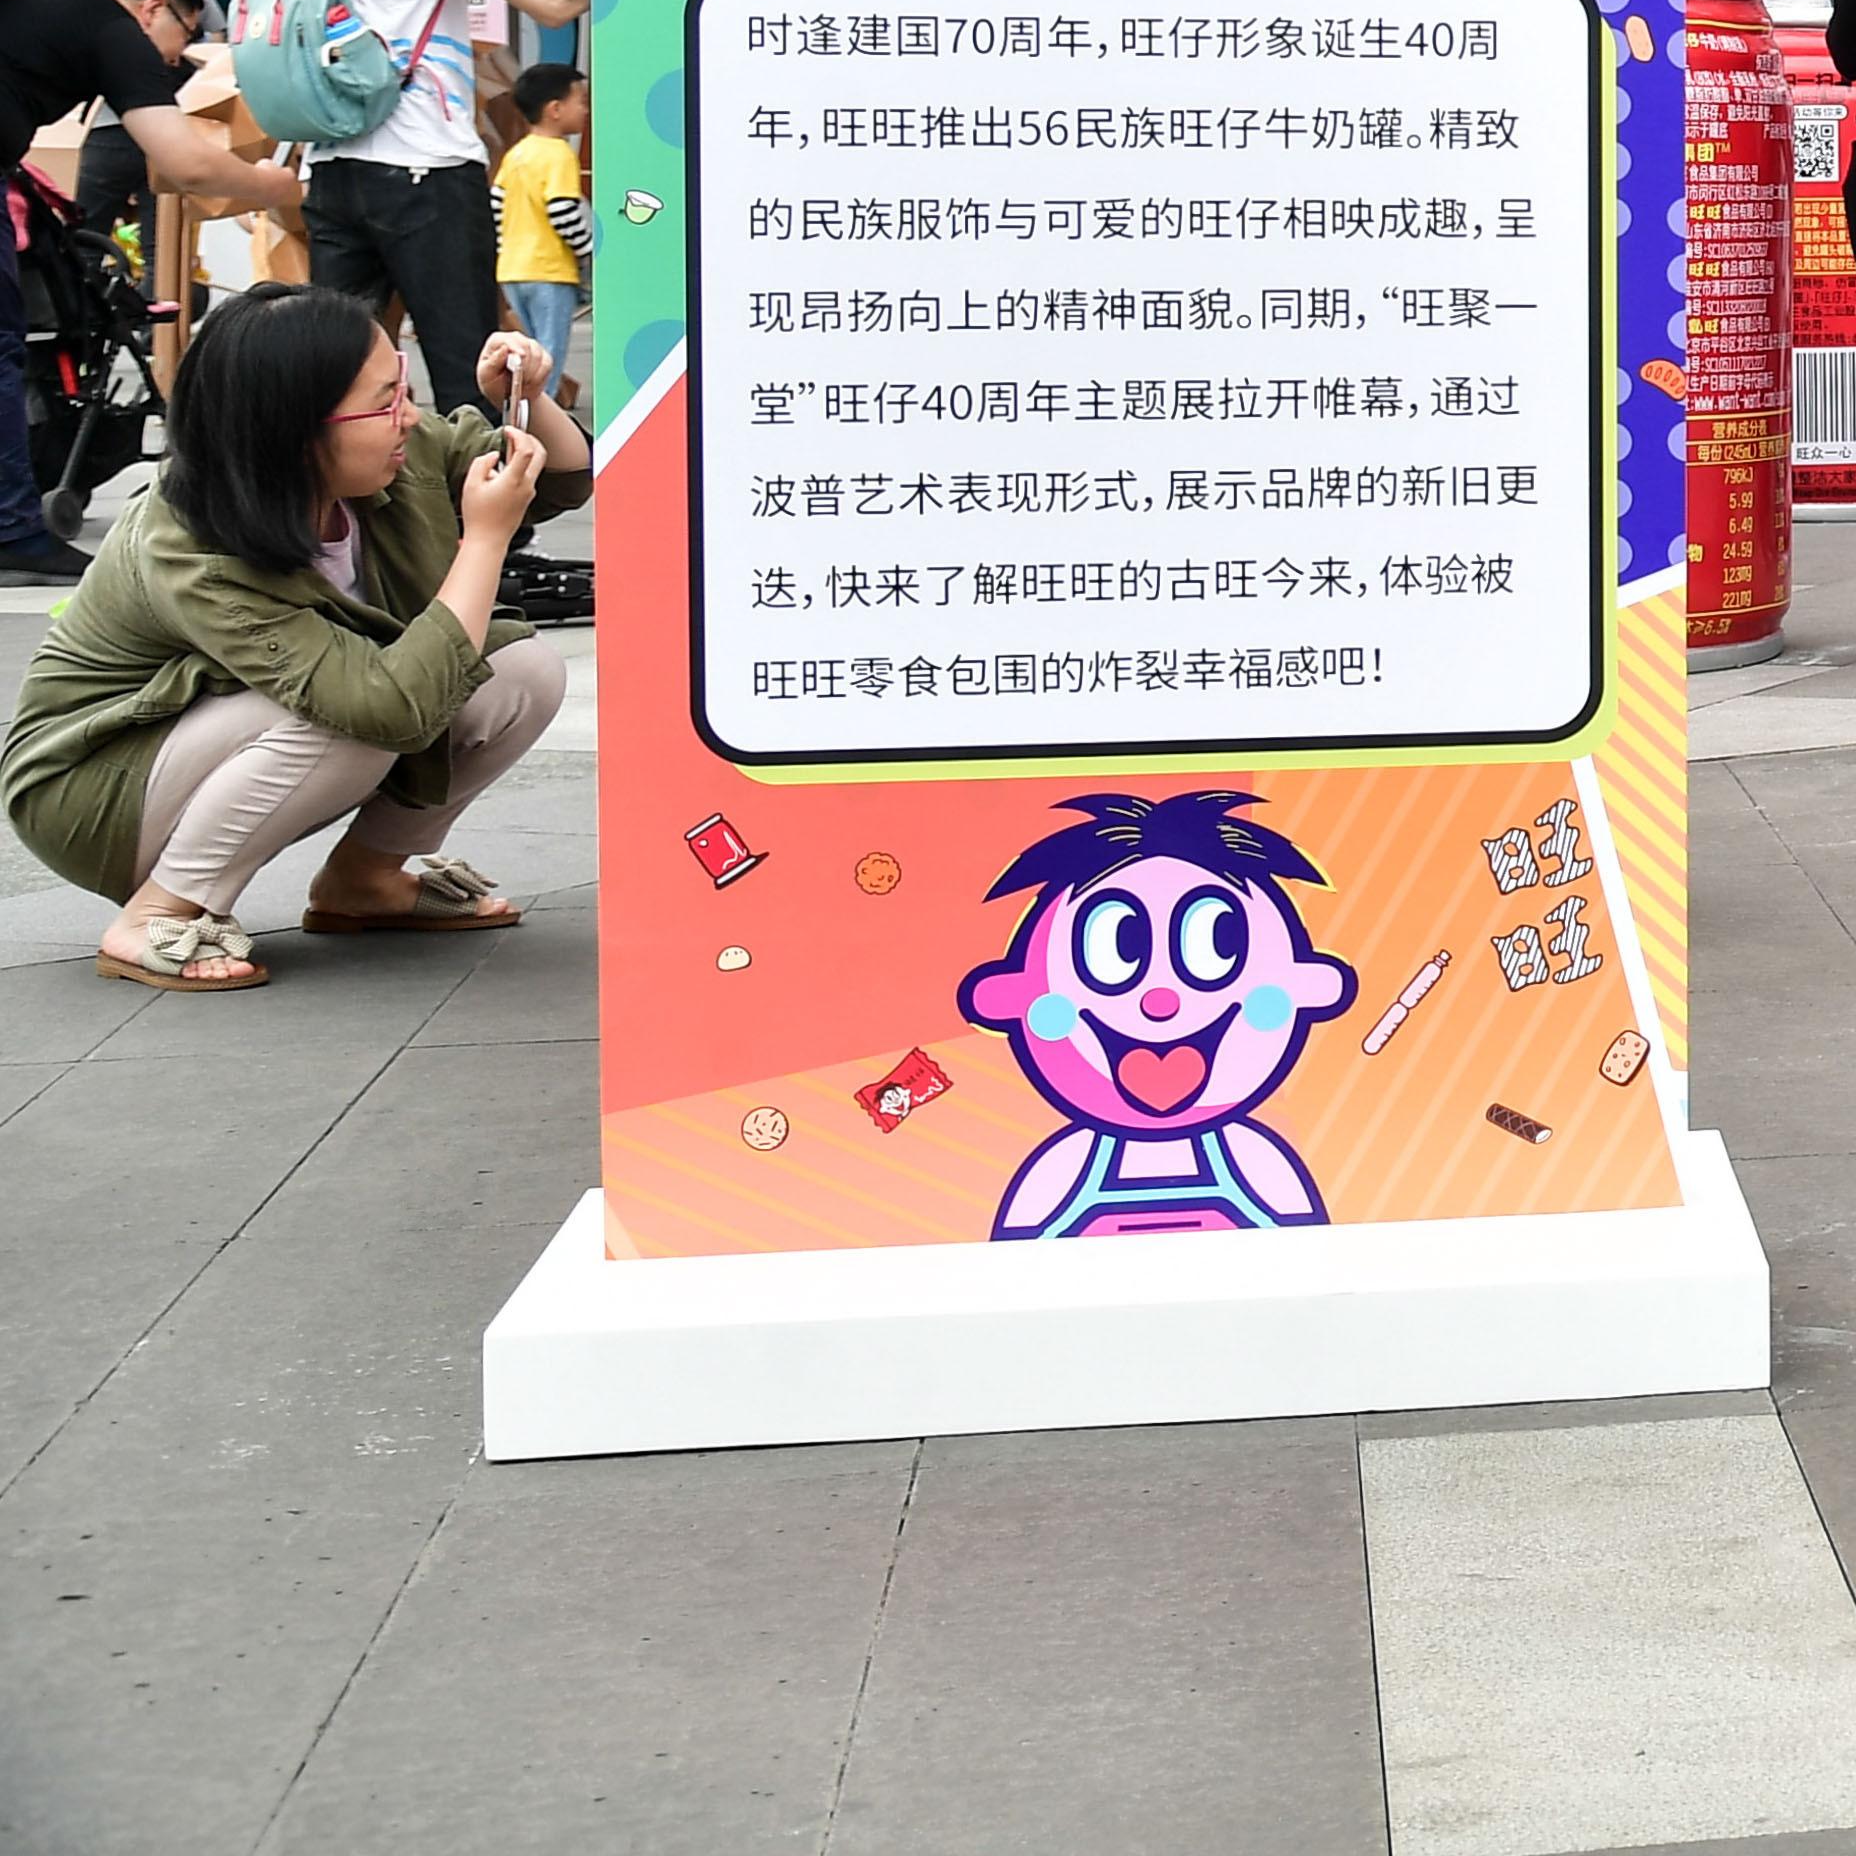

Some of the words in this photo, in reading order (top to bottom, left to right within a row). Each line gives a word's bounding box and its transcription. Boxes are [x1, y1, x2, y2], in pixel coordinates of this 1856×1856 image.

[1686, 165, 1758, 182] 食品集团有限公司
[1712, 420, 1767, 439] 营养成分表
[1796, 447, 1852, 460] 旺众一心
[1484, 797, 1596, 896] 旺
[1492, 896, 1605, 994] 旺
